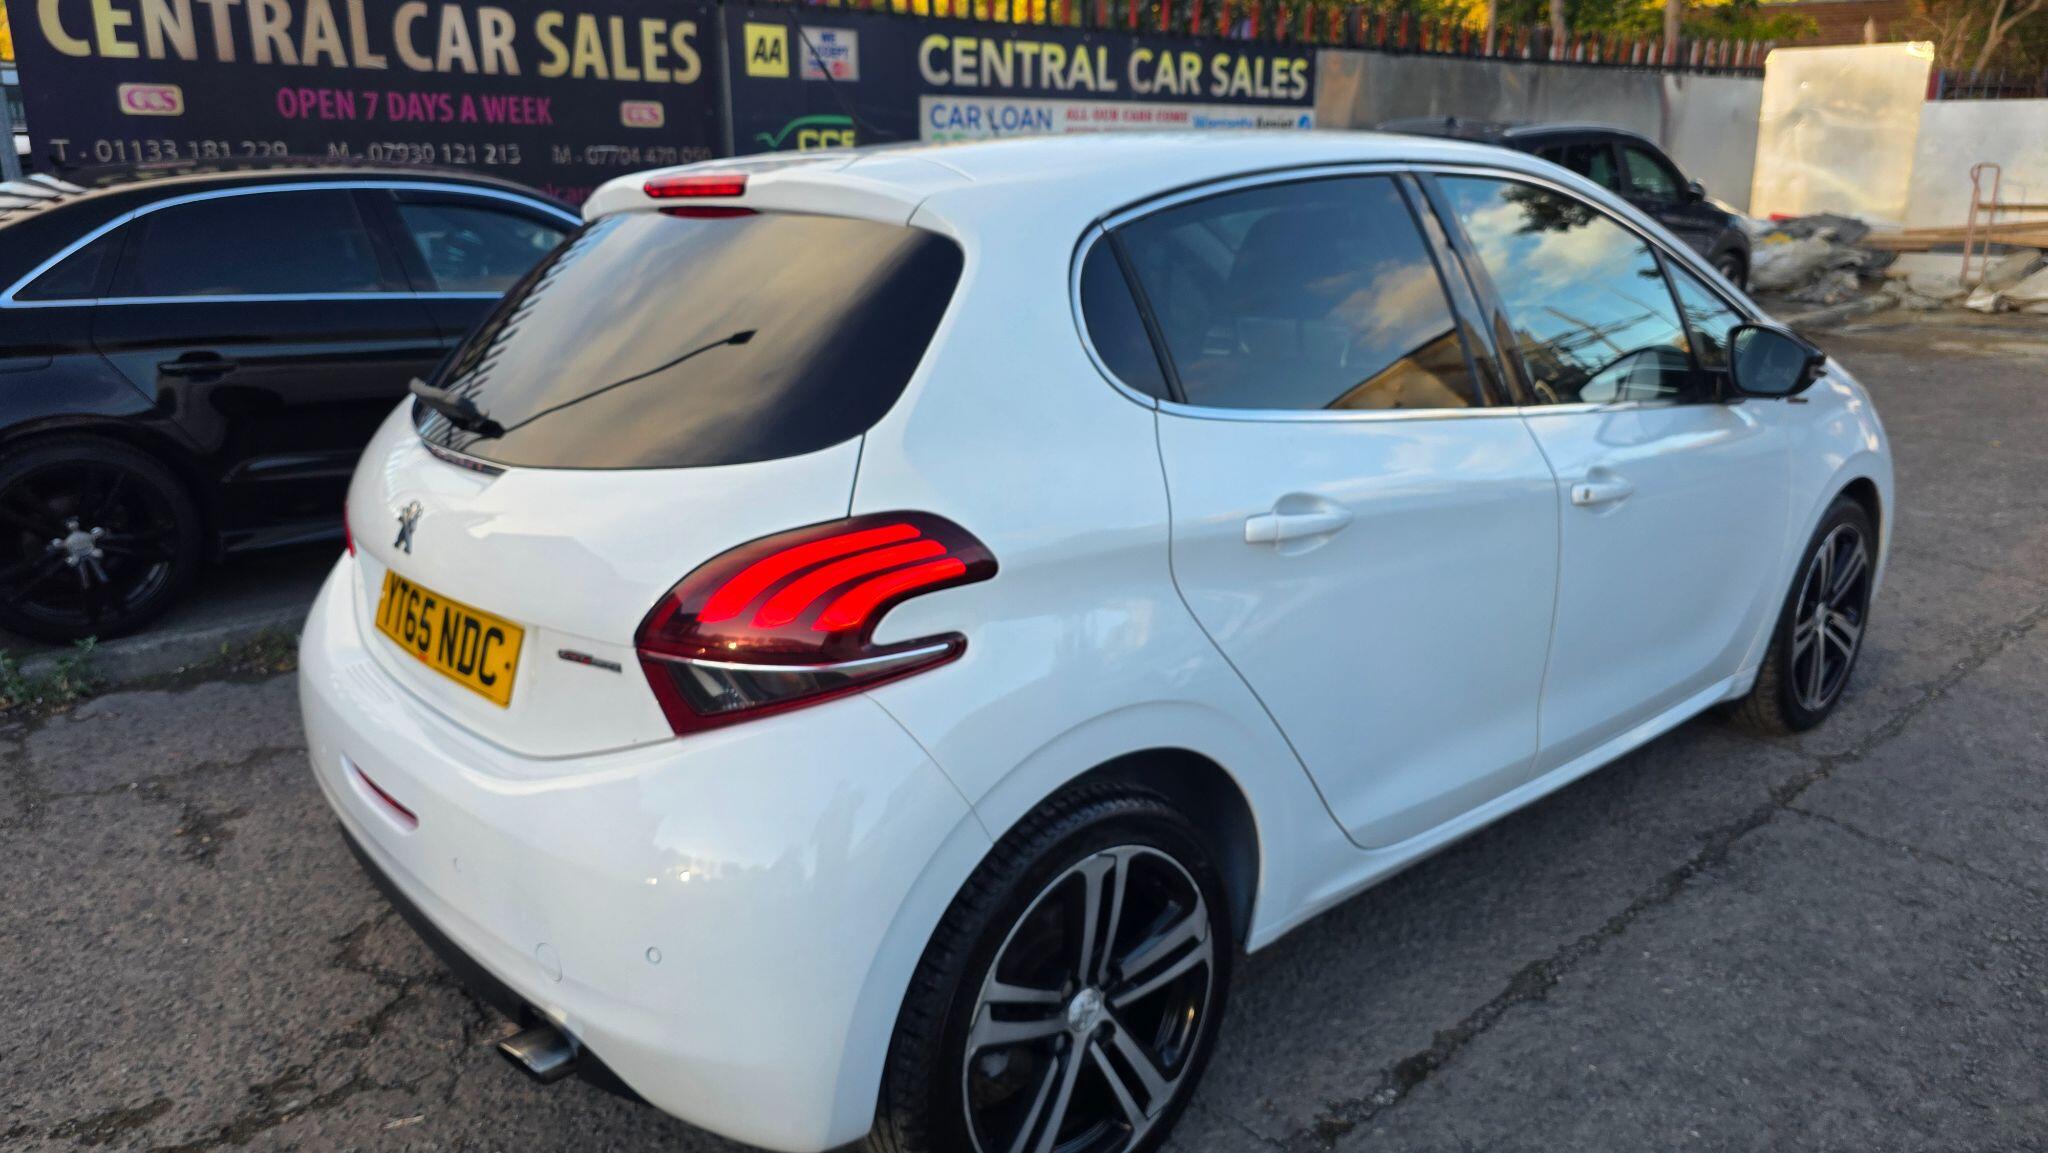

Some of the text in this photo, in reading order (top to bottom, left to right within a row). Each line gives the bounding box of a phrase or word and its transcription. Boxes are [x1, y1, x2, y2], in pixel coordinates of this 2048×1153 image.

[37, 0, 702, 84] CENTRAL CAR SALES
[753, 36, 782, 63] AA
[919, 33, 1308, 100] CENTRAL CAR SALES
[277, 86, 553, 125] OPEN 7 DAYS A WEEK
[930, 104, 1053, 132] CAR LOAN
[50, 139, 70, 161] T
[95, 139, 179, 162] 01133
[443, 143, 476, 163] 121
[485, 143, 521, 164] 213
[385, 572, 504, 686] YT65 NDC
